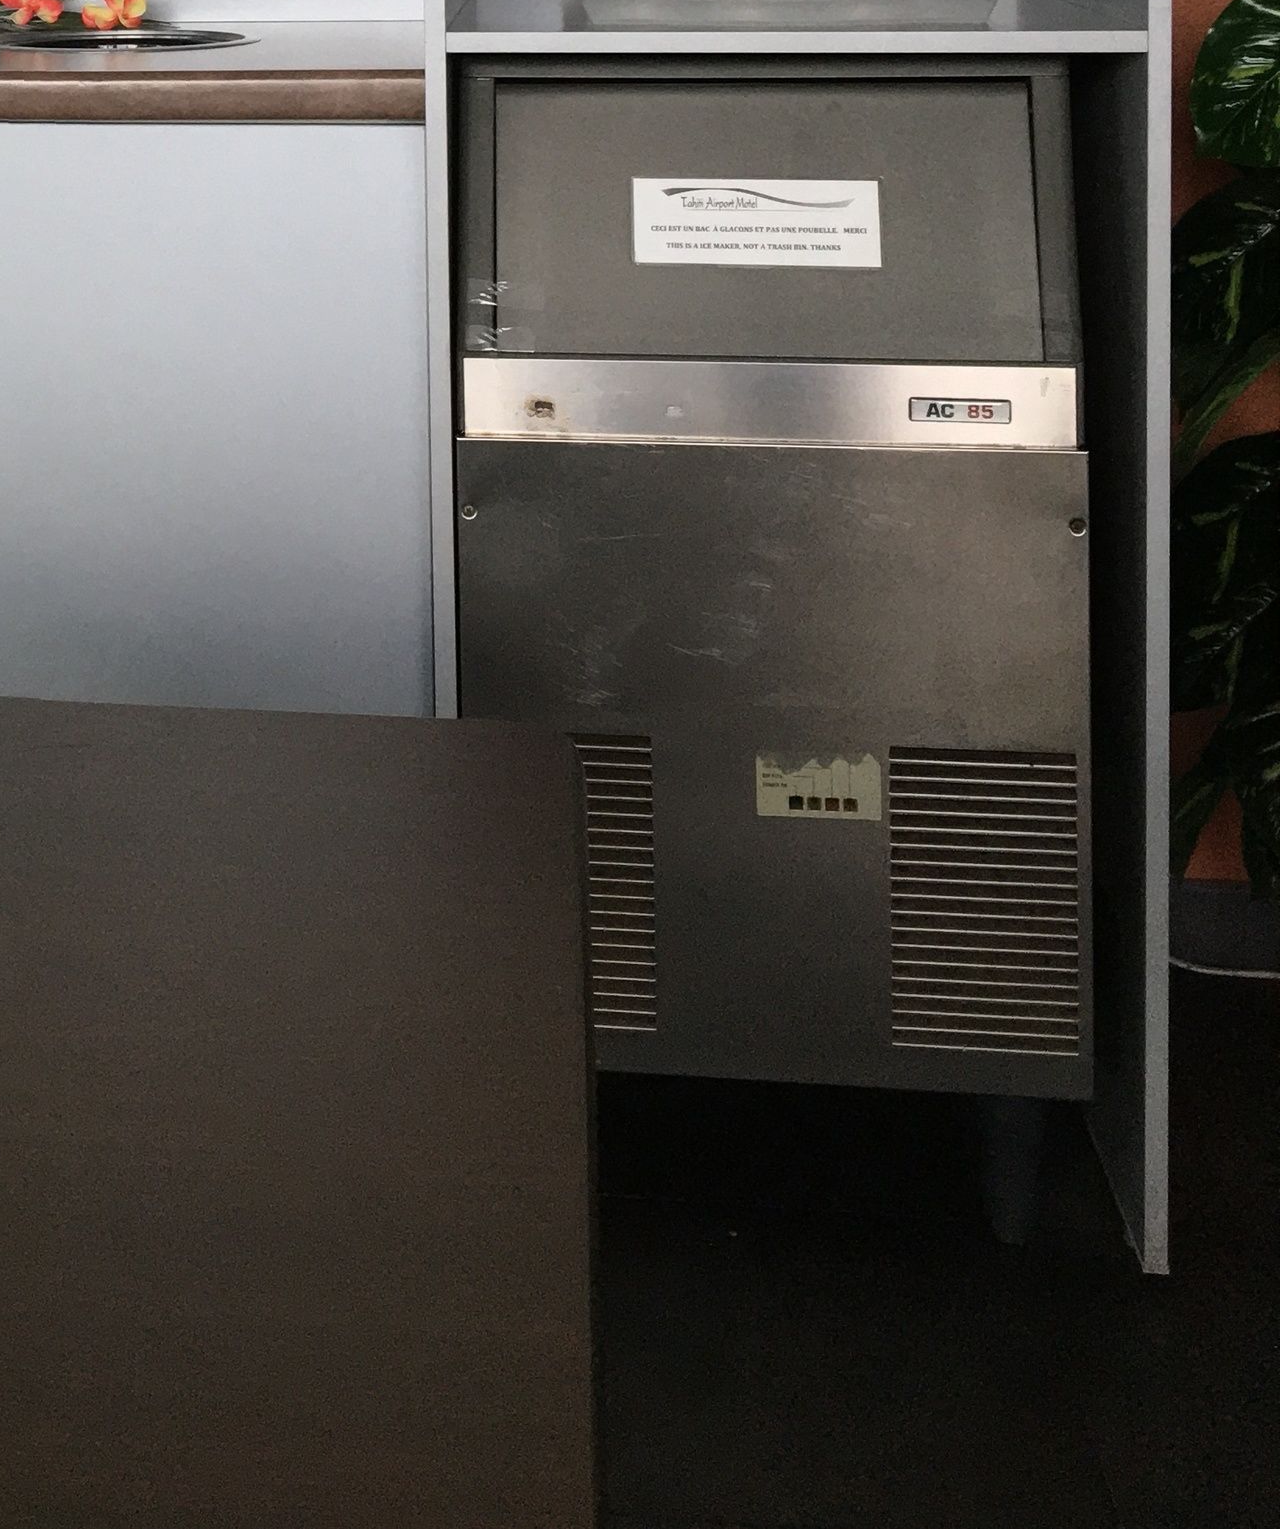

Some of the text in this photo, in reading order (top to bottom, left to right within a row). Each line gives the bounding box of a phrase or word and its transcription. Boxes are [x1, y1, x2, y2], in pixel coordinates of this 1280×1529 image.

[705, 197, 735, 210] Airport
[695, 225, 710, 233] BAC
[700, 242, 712, 250] ICE
[767, 243, 792, 251] TRASH
[810, 243, 841, 251] THANKS
[926, 402, 994, 419] AC 85
